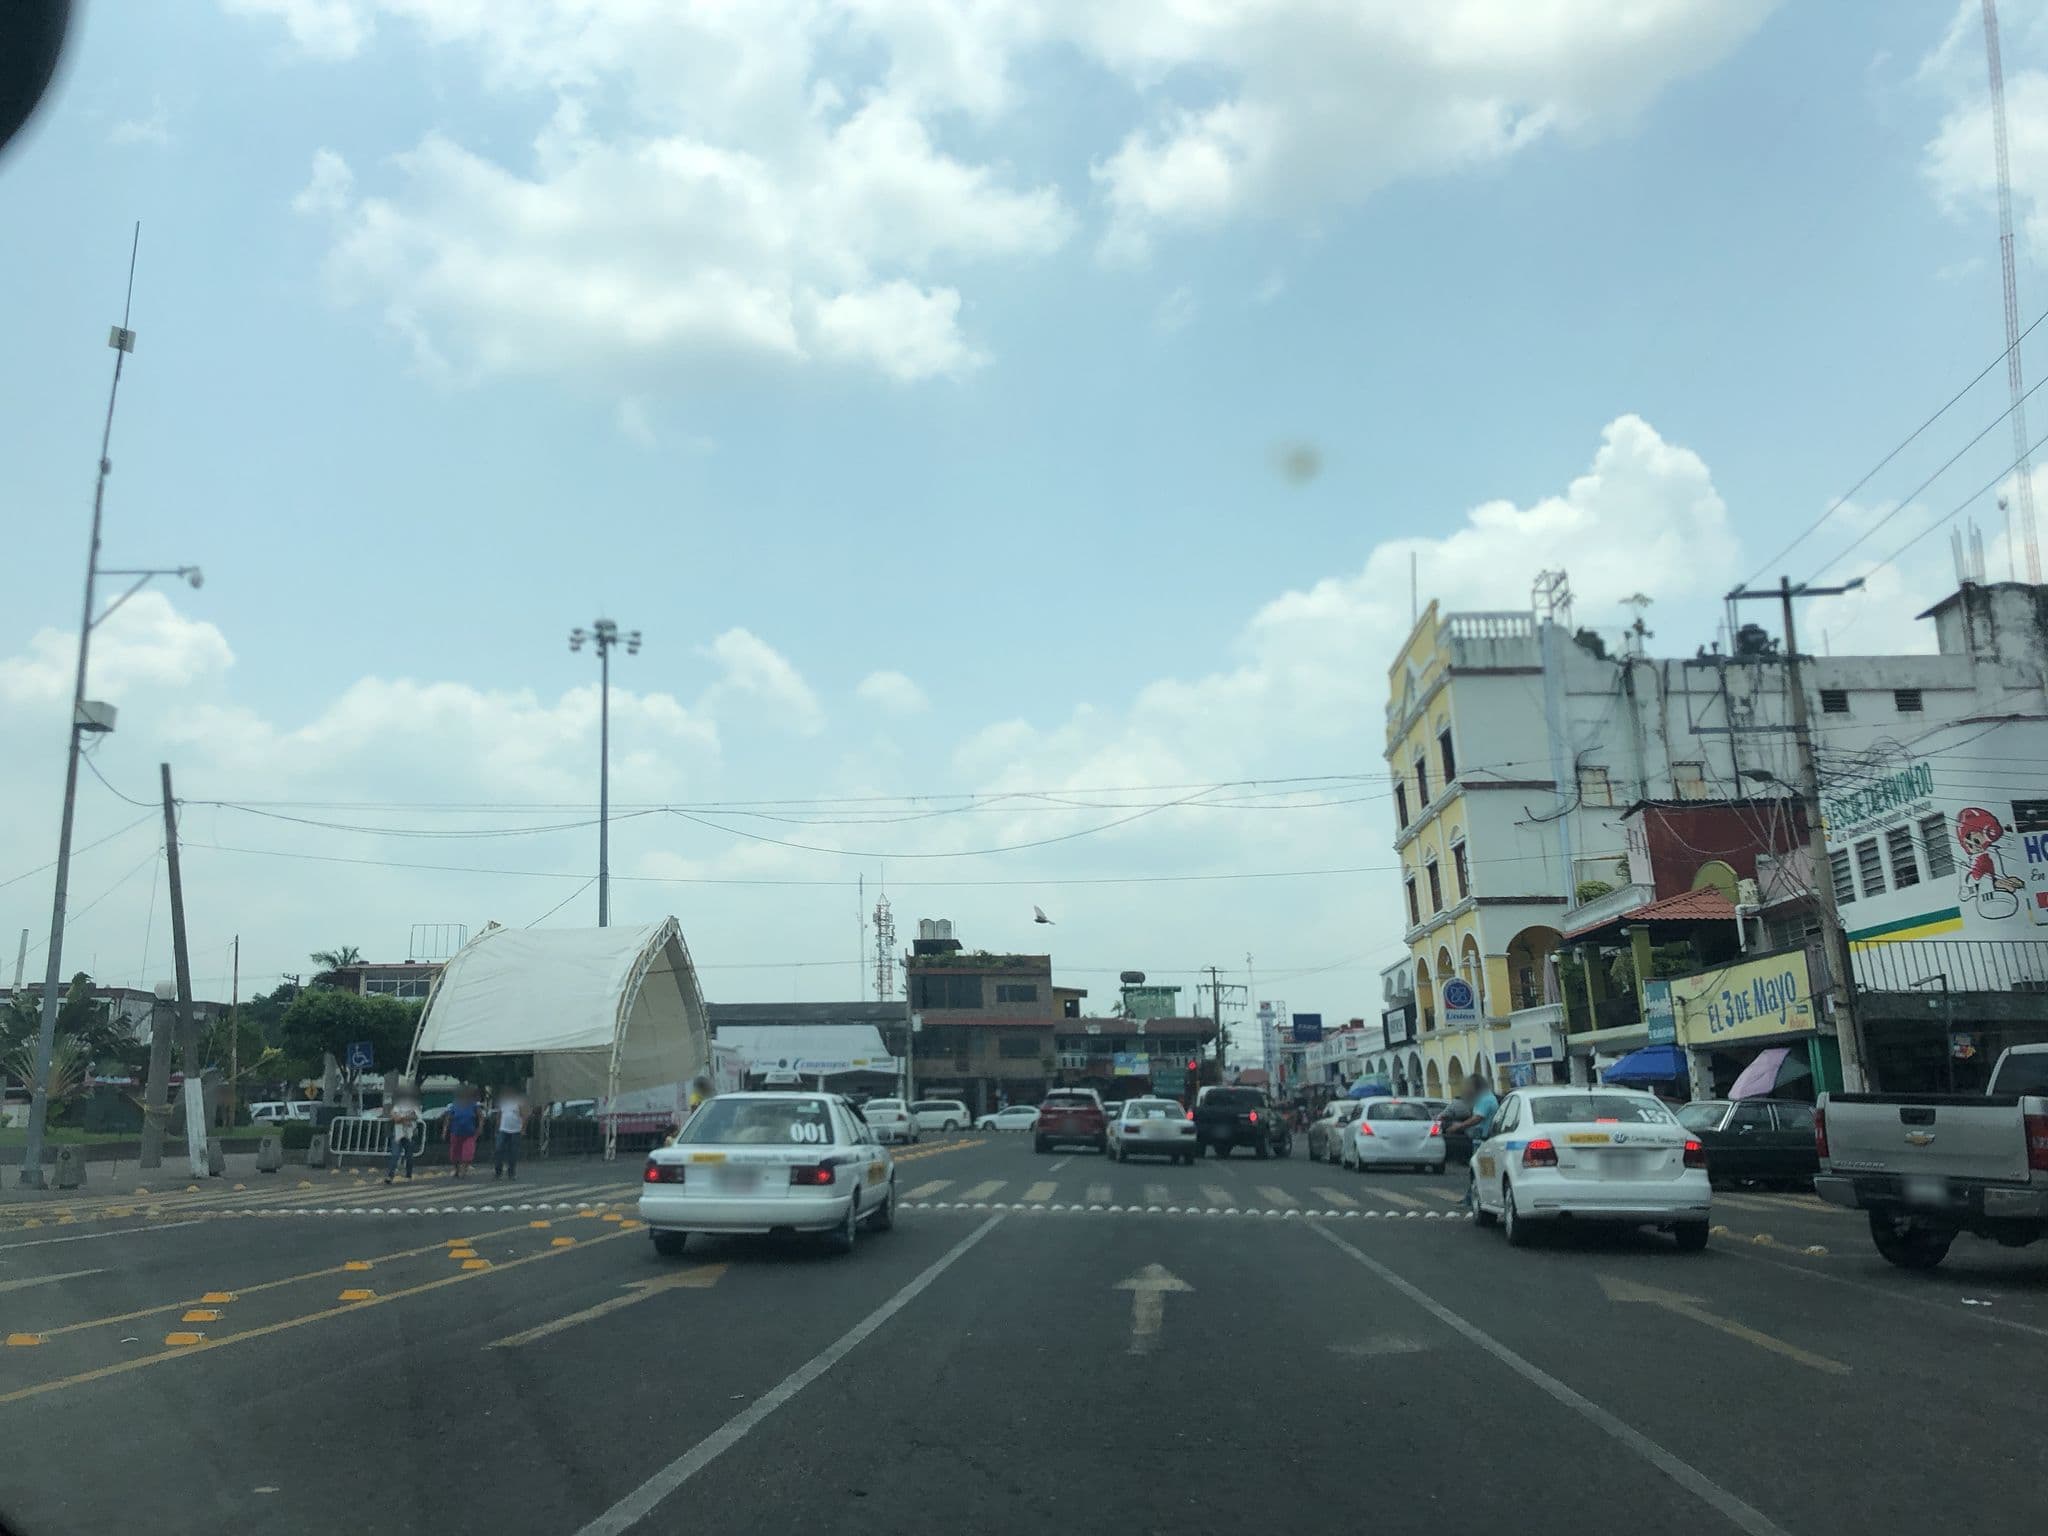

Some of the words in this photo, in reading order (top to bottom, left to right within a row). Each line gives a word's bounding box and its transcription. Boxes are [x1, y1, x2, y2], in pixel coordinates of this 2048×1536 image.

[1707, 1003, 1724, 1034] EL
[1722, 989, 1735, 1028] 3
[1734, 989, 1752, 1024] DE
[1752, 970, 1797, 1026] Mayo
[789, 1122, 829, 1144] 001
